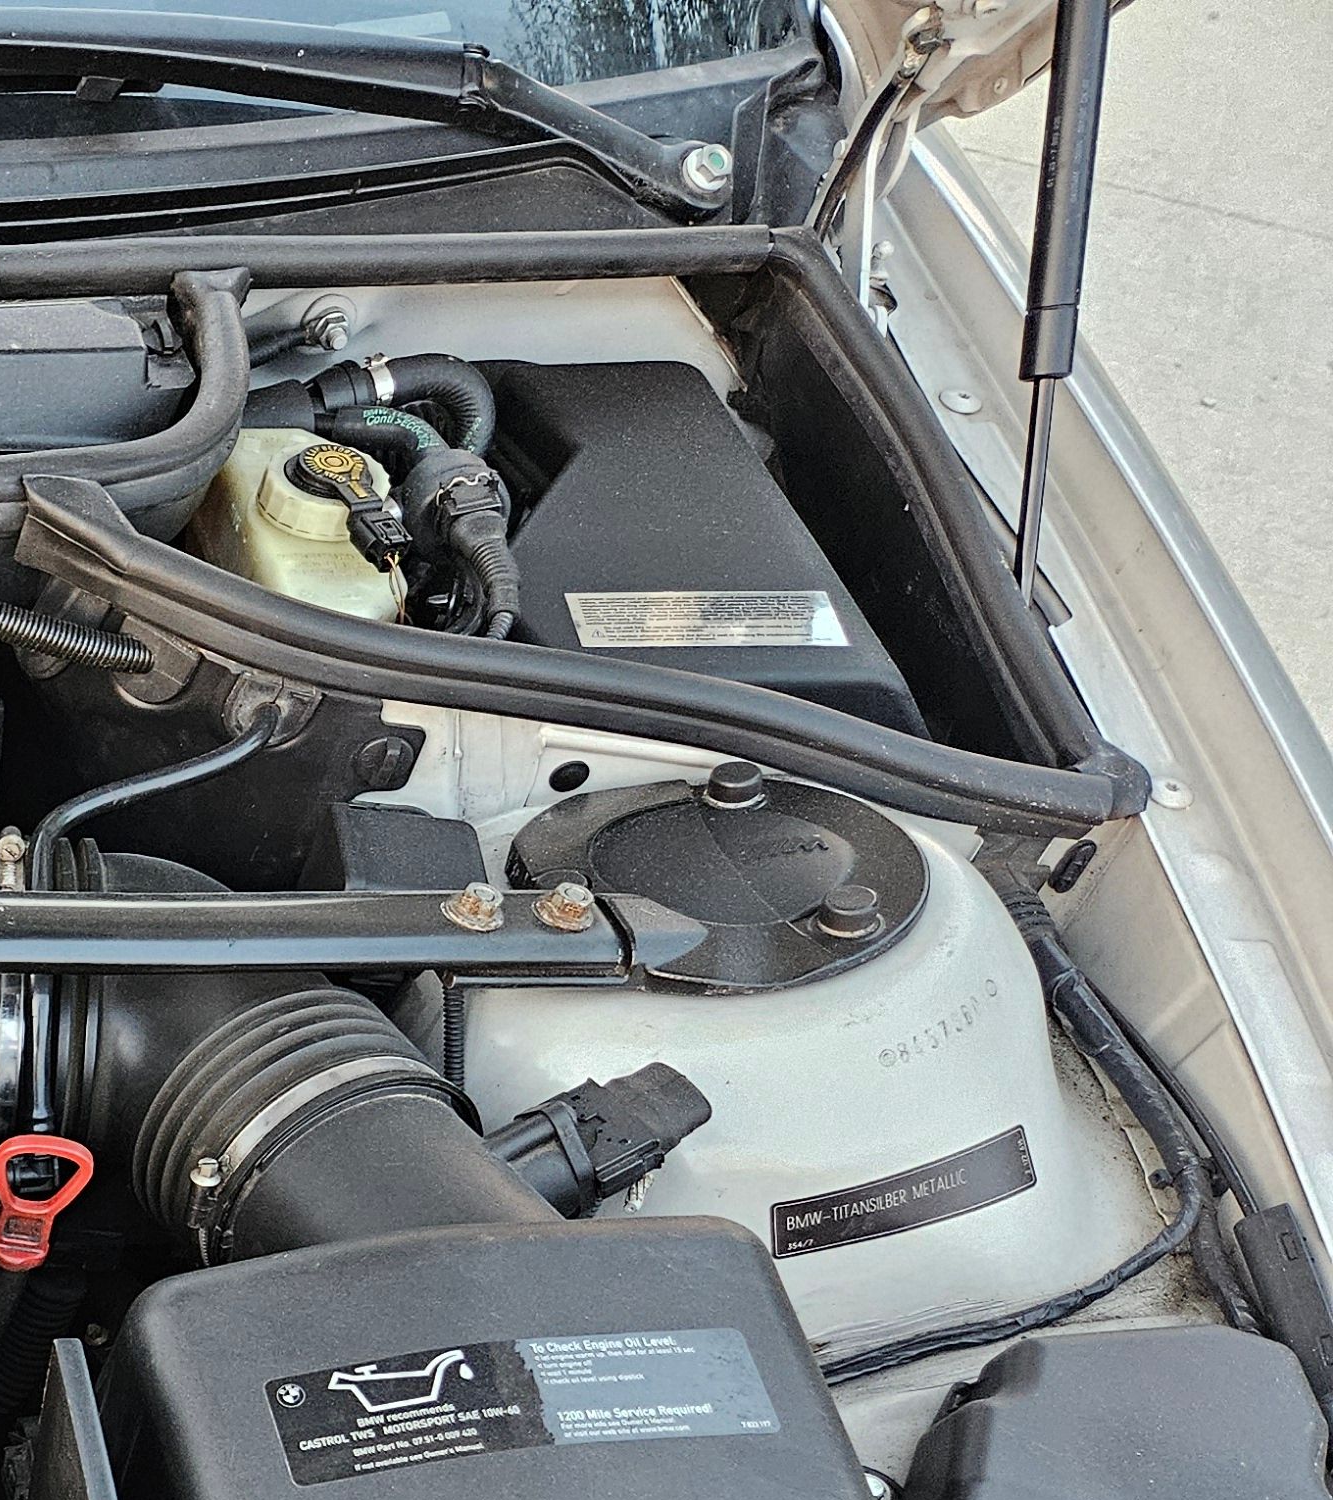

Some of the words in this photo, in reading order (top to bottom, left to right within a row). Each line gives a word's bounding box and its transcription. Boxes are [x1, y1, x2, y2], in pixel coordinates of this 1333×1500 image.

[786, 1189, 907, 1231] BMW-TITANSILBER
[912, 1168, 969, 1200] METALLIC
[529, 1343, 545, 1354] To
[545, 1341, 582, 1353] Check
[583, 1339, 623, 1352] Engine
[624, 1337, 642, 1348] Oil
[551, 1354, 574, 1362] engine
[559, 1361, 582, 1369] engine
[597, 1375, 617, 1383] using
[356, 1414, 385, 1428] BMW
[386, 1402, 456, 1423] recommends
[557, 1411, 585, 1421] 1200
[586, 1409, 612, 1420] Mile
[613, 1406, 656, 1418] Service
[657, 1402, 712, 1417] Required!
[299, 1433, 350, 1451] CASTROL
[350, 1428, 376, 1442] TWS
[383, 1414, 456, 1437] MOTORSPORT
[458, 1409, 481, 1423] SAE
[481, 1404, 521, 1420] 10W-60
[352, 1446, 375, 1457] BMW
[376, 1442, 395, 1453] Part
